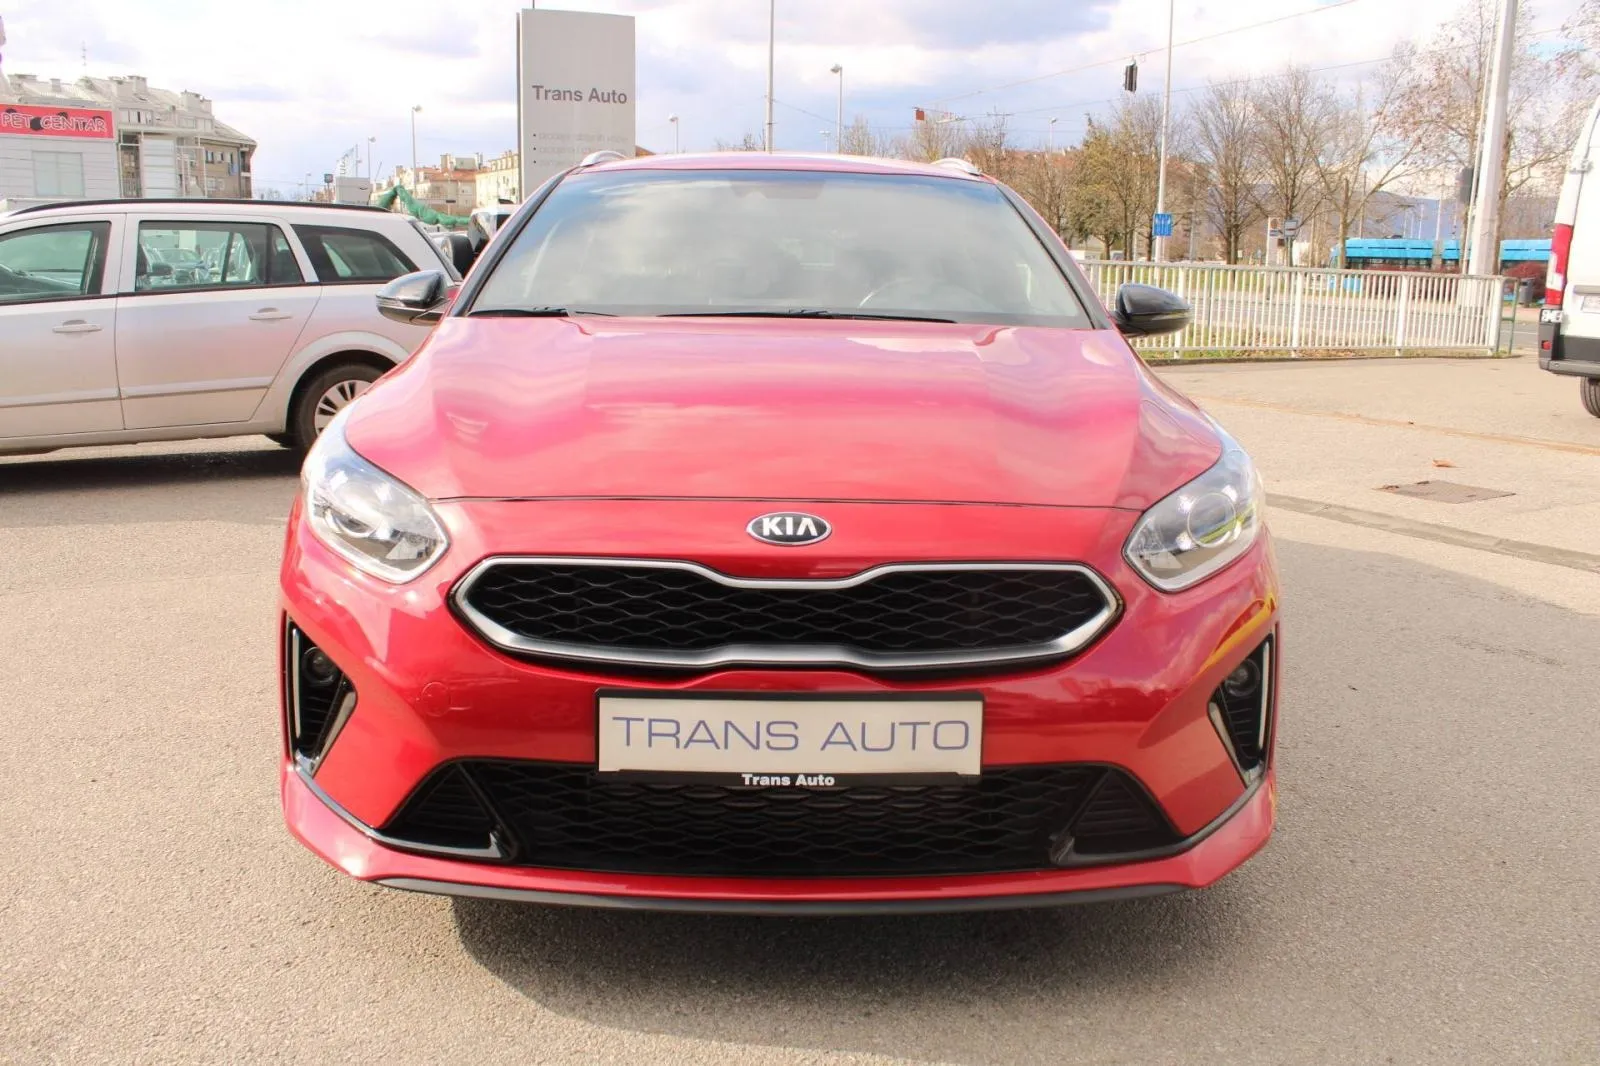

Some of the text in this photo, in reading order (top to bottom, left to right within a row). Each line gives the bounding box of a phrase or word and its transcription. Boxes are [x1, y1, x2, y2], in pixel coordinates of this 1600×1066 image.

[532, 85, 628, 104] Trans Auto
[1, 112, 107, 132] PET CENTAR
[762, 516, 818, 536] KIA
[612, 717, 969, 751] TRANS AUTO
[741, 773, 835, 786] Trans Auto
